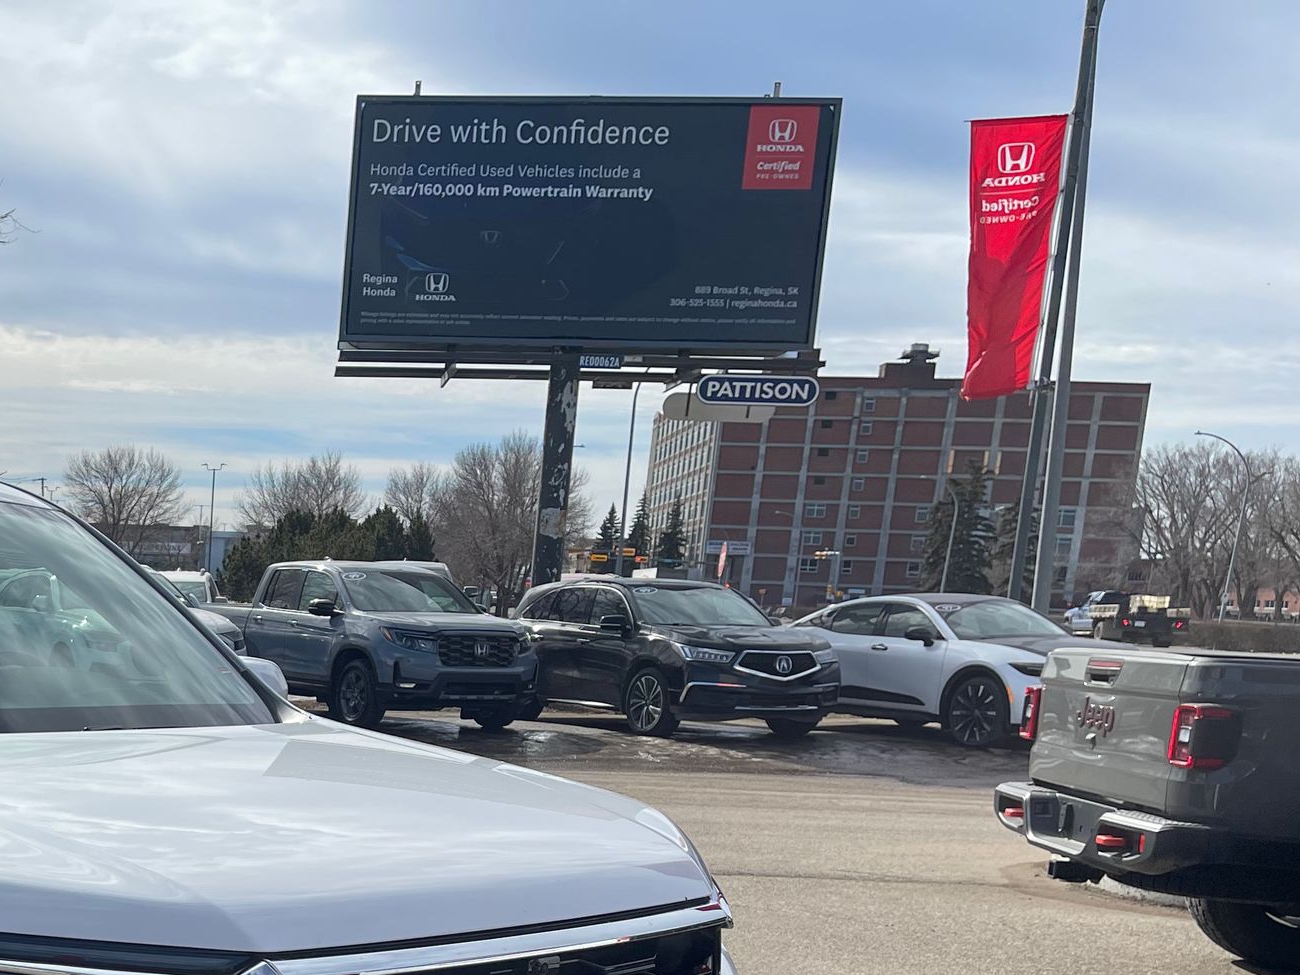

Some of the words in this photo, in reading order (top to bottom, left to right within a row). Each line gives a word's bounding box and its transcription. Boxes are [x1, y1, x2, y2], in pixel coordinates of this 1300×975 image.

[371, 119, 442, 143] Drive
[450, 119, 507, 144] with
[516, 119, 670, 145] Confidence
[756, 144, 804, 152] HONDA
[370, 163, 414, 177] Honda
[417, 163, 476, 177] Certified
[480, 164, 514, 178] Used
[518, 164, 575, 178] Vehicles
[578, 165, 630, 179] include
[632, 168, 642, 179] a
[756, 160, 801, 172] Certified
[369, 183, 475, 197] 7-Year/160,000
[477, 184, 500, 197] km
[503, 184, 582, 198] Powertrain
[585, 186, 654, 201] Warranty
[362, 273, 398, 285] Regina
[362, 287, 396, 297] Honda
[580, 355, 620, 367] RE00062A
[706, 380, 810, 400] PATTISON
[1076, 695, 1116, 738] Jeep
